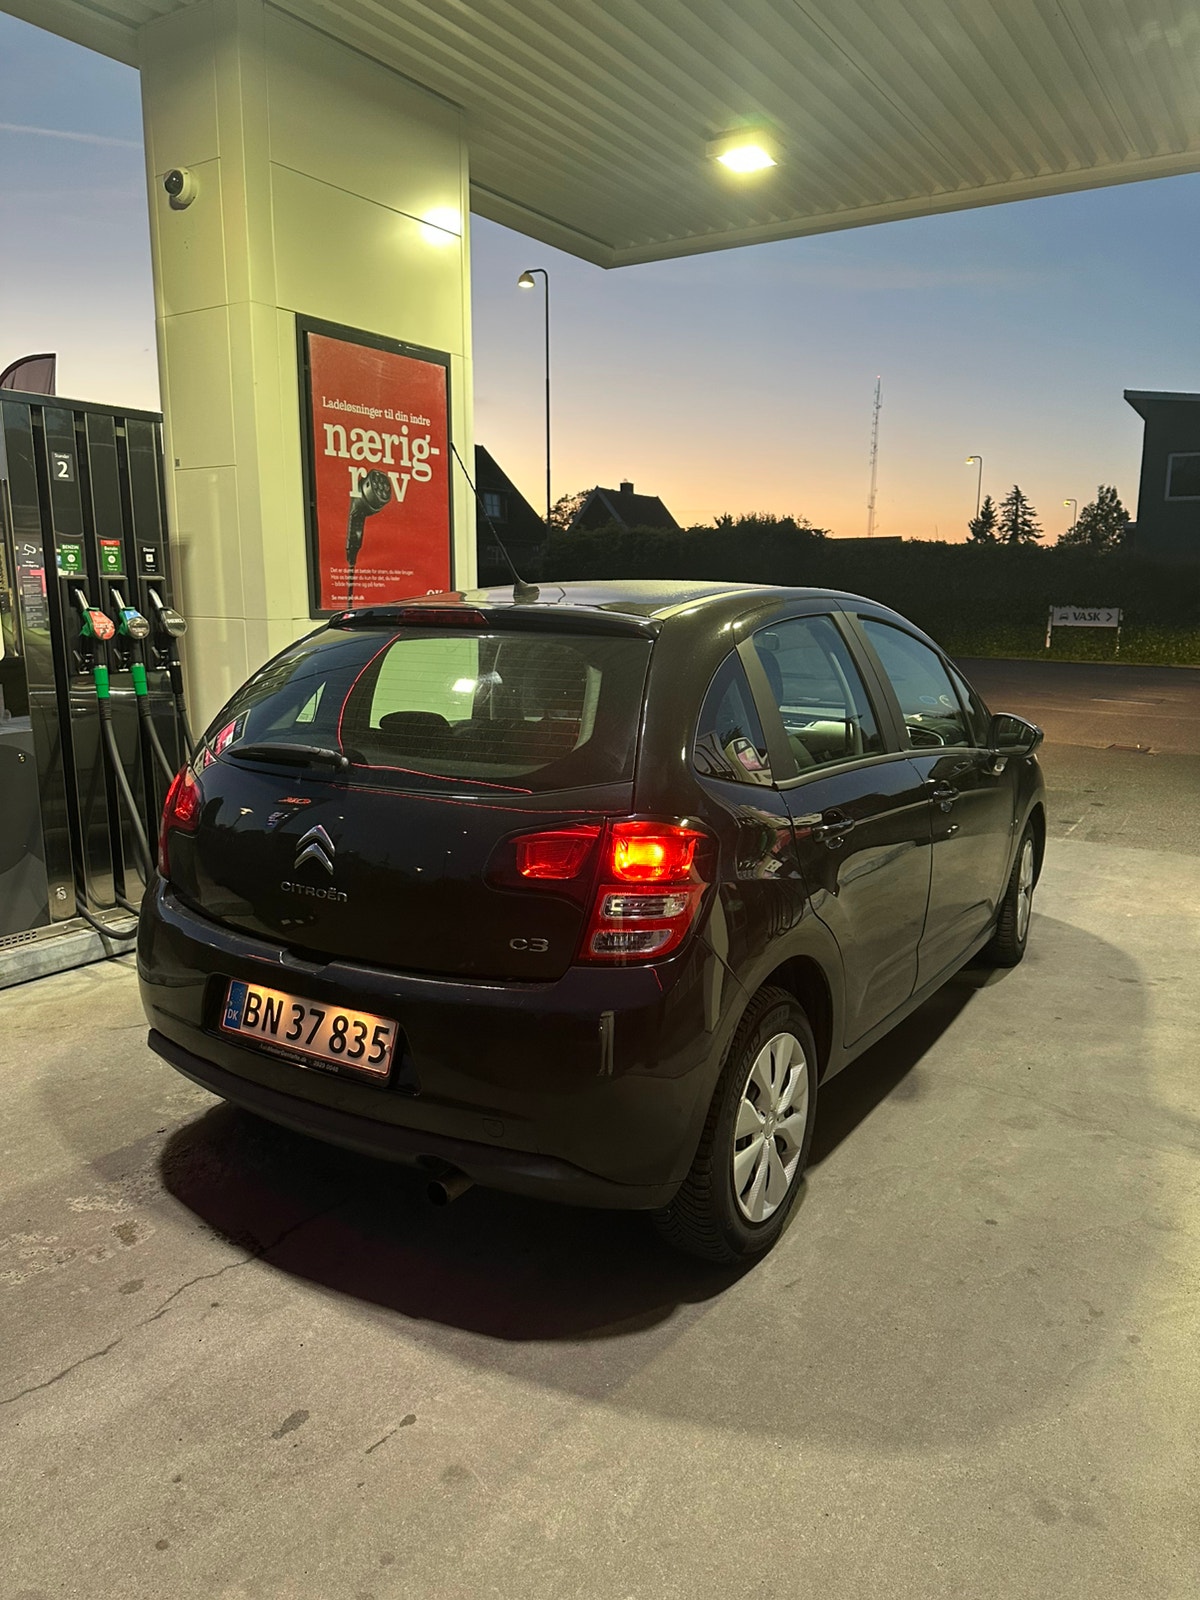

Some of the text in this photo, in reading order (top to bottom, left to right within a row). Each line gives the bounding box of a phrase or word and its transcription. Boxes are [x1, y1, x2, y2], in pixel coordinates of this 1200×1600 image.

[322, 396, 431, 426] Ladeløsninger til din indre
[323, 423, 440, 482] nærig-
[57, 461, 69, 478] 2
[348, 466, 411, 503] rv
[1073, 612, 1100, 621] VASK
[509, 937, 549, 952] C3
[227, 1008, 239, 1021] DK
[243, 992, 284, 1035] BN
[286, 1004, 326, 1045] 37
[329, 1015, 389, 1064] 835
